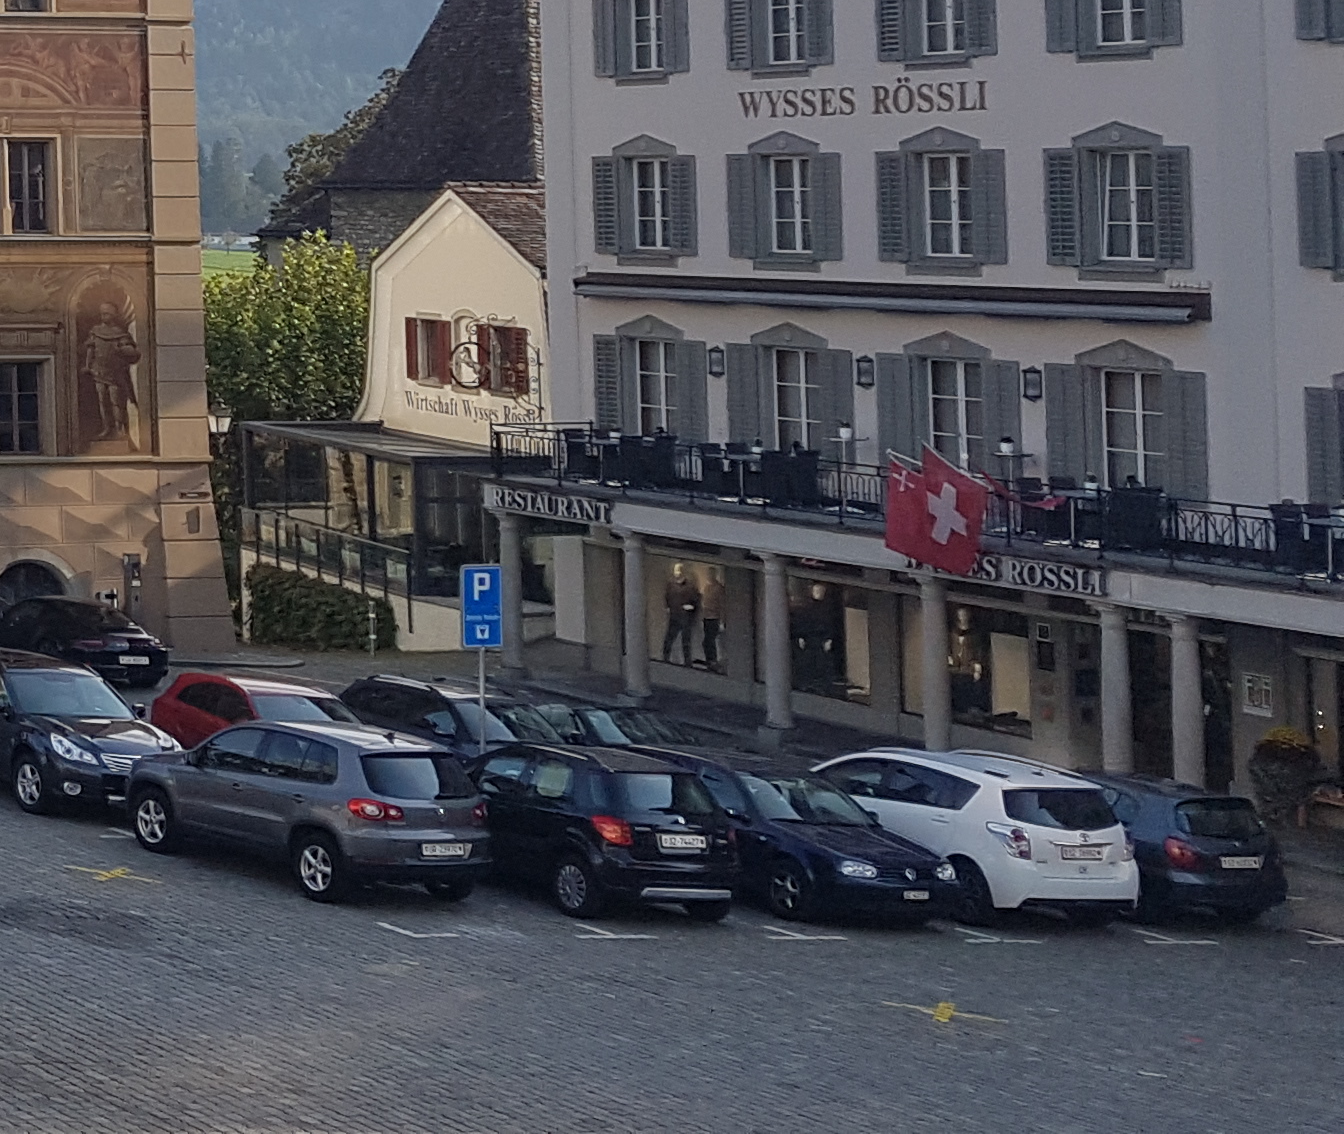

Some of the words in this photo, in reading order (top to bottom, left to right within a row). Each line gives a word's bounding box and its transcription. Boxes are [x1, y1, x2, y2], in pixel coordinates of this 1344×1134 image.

[738, 86, 856, 118] WYSSES
[871, 76, 988, 115] RÖSSLI
[404, 390, 458, 417] Wirtschaft
[462, 399, 499, 423] Wysses
[492, 487, 610, 524] RESTAURANT
[473, 572, 491, 601] P
[1010, 559, 1103, 596] RÖSSLI
